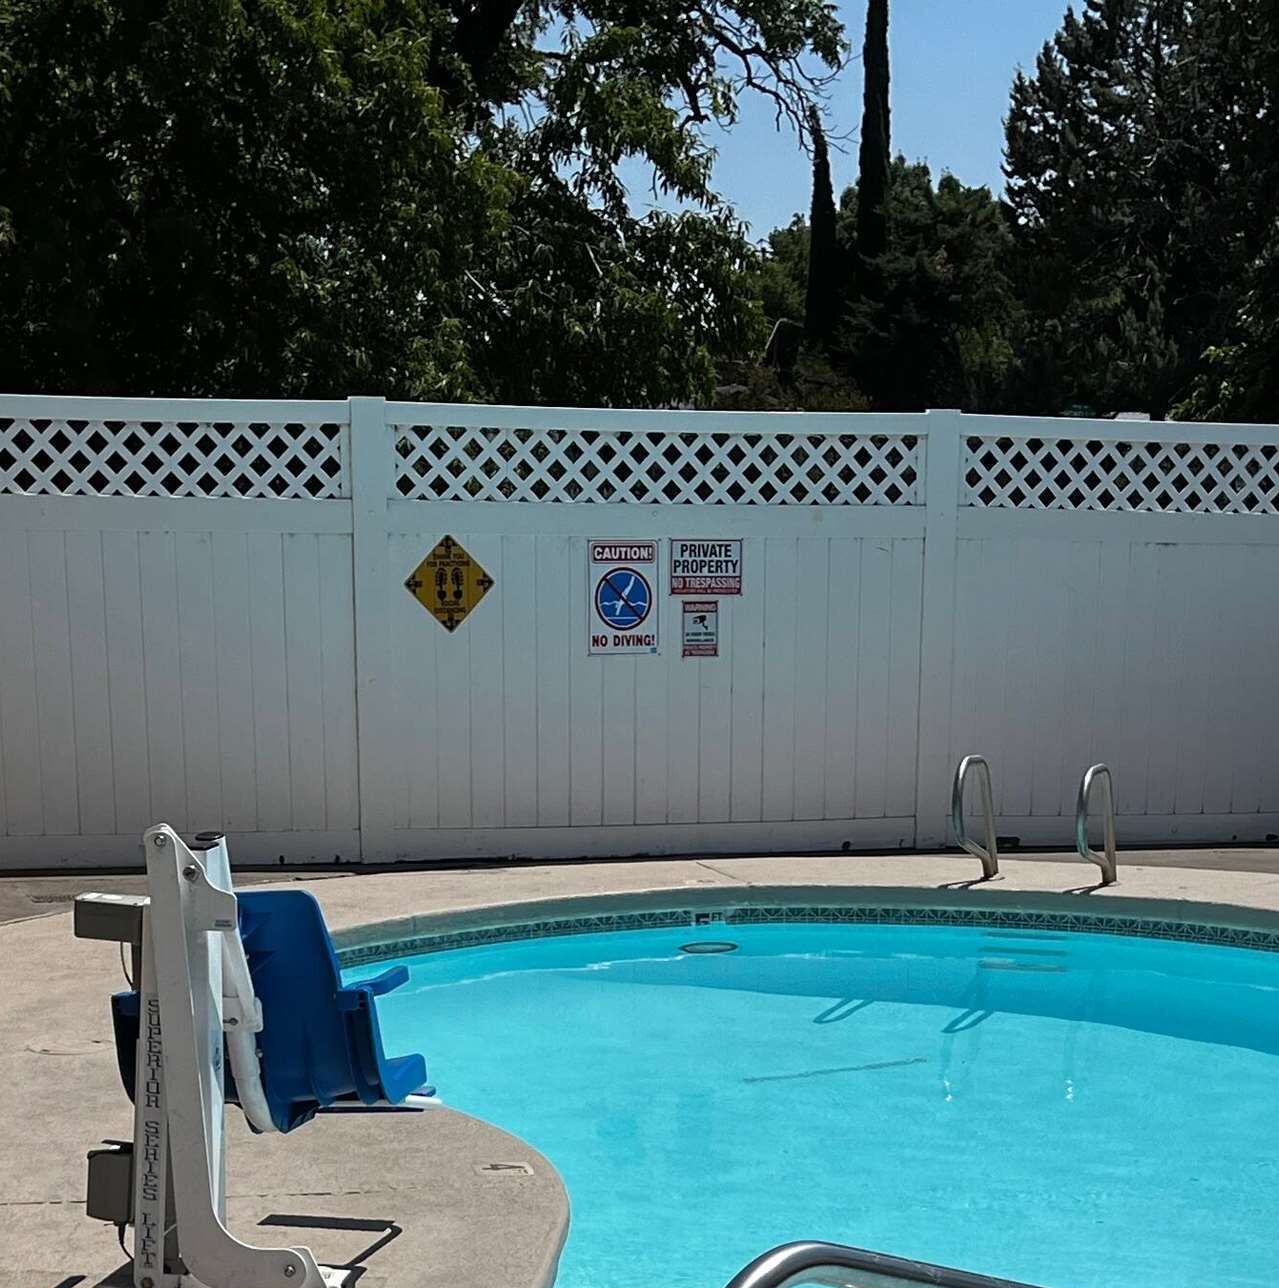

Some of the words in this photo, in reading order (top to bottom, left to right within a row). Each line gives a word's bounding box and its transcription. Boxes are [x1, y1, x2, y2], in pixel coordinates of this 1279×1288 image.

[594, 547, 652, 560] CAUTION!
[680, 544, 732, 558] PRIVATE
[673, 560, 738, 574] PROPERTY
[672, 577, 684, 588] NO
[685, 577, 740, 588] TRESPASSING
[592, 635, 608, 647] NO
[613, 635, 656, 647] DIVING!
[145, 999, 162, 1108] SUPERIOR
[142, 1120, 161, 1201] SERIES
[141, 1212, 157, 1265] LIFT
